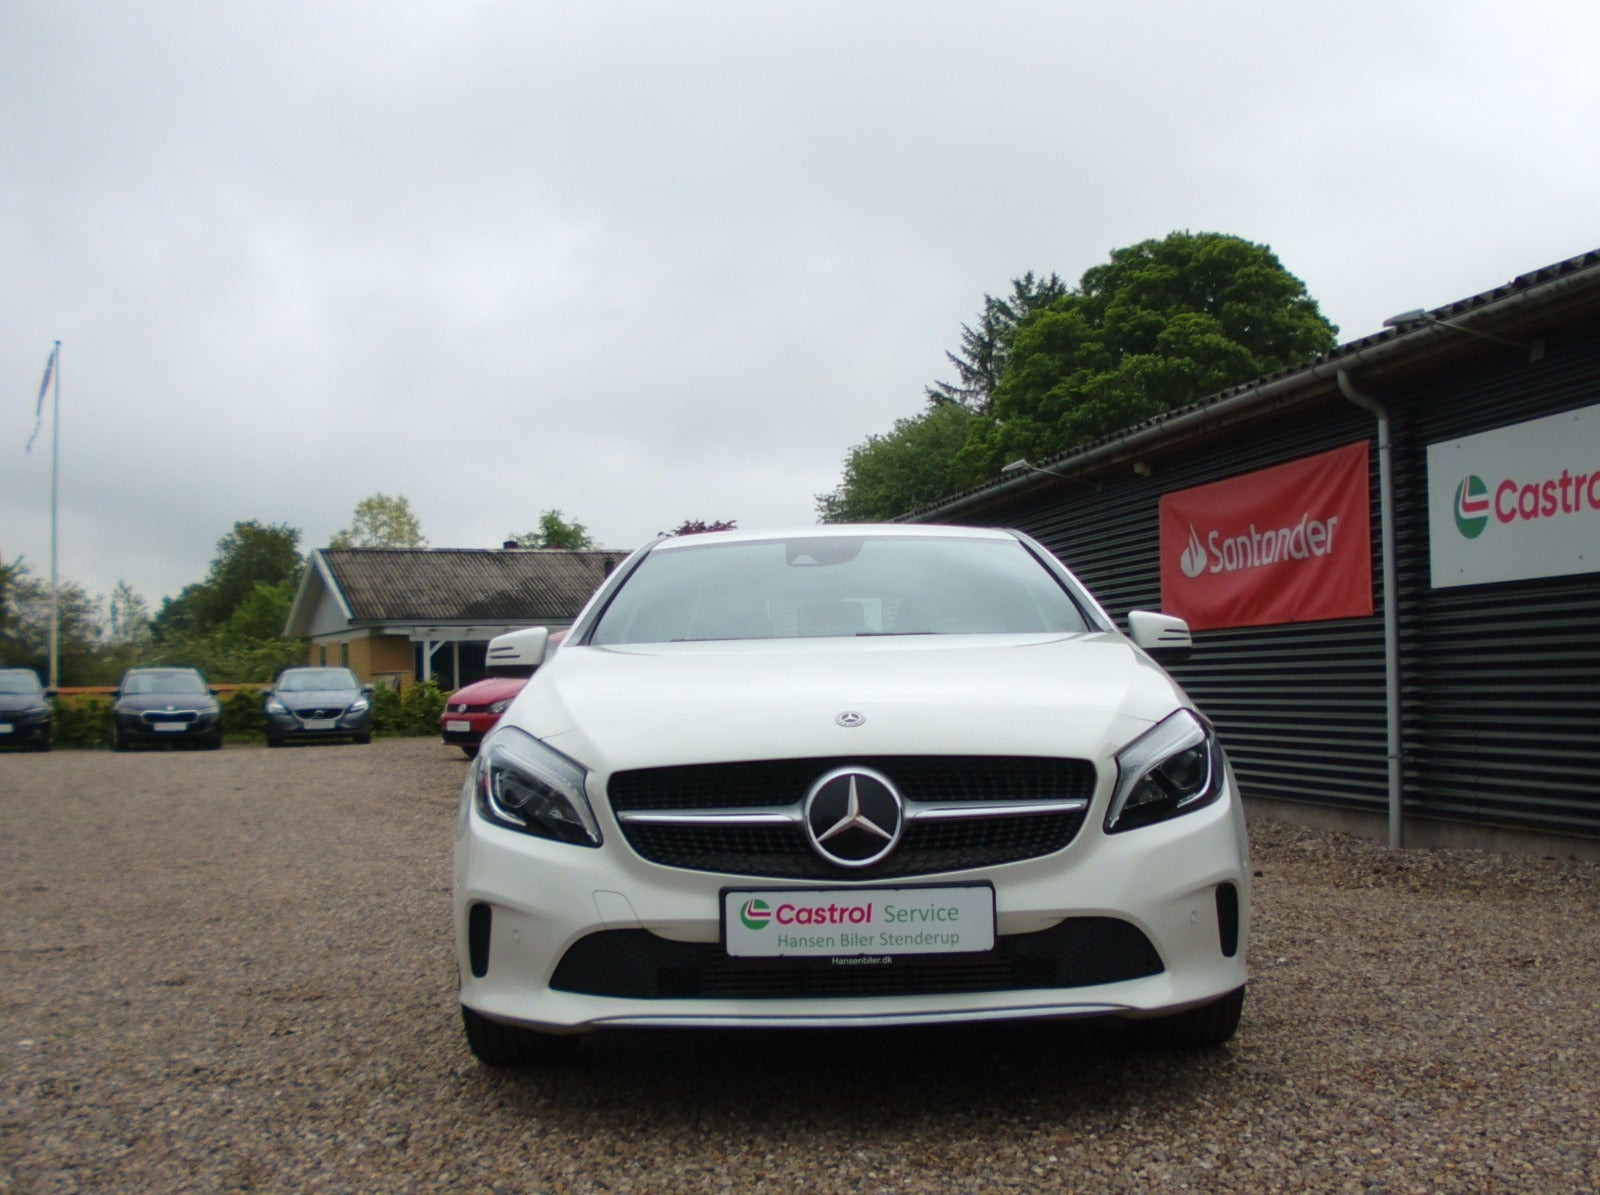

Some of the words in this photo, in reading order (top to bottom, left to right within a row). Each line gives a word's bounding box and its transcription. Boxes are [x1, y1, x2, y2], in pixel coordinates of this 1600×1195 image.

[1208, 512, 1338, 574] Santander
[775, 902, 873, 925] Castrol
[884, 904, 959, 923] Service
[777, 933, 835, 948] Hansen
[840, 932, 874, 947] Biler
[879, 931, 960, 947] Stenderup
[831, 956, 893, 965] Hansenbiler.dk
